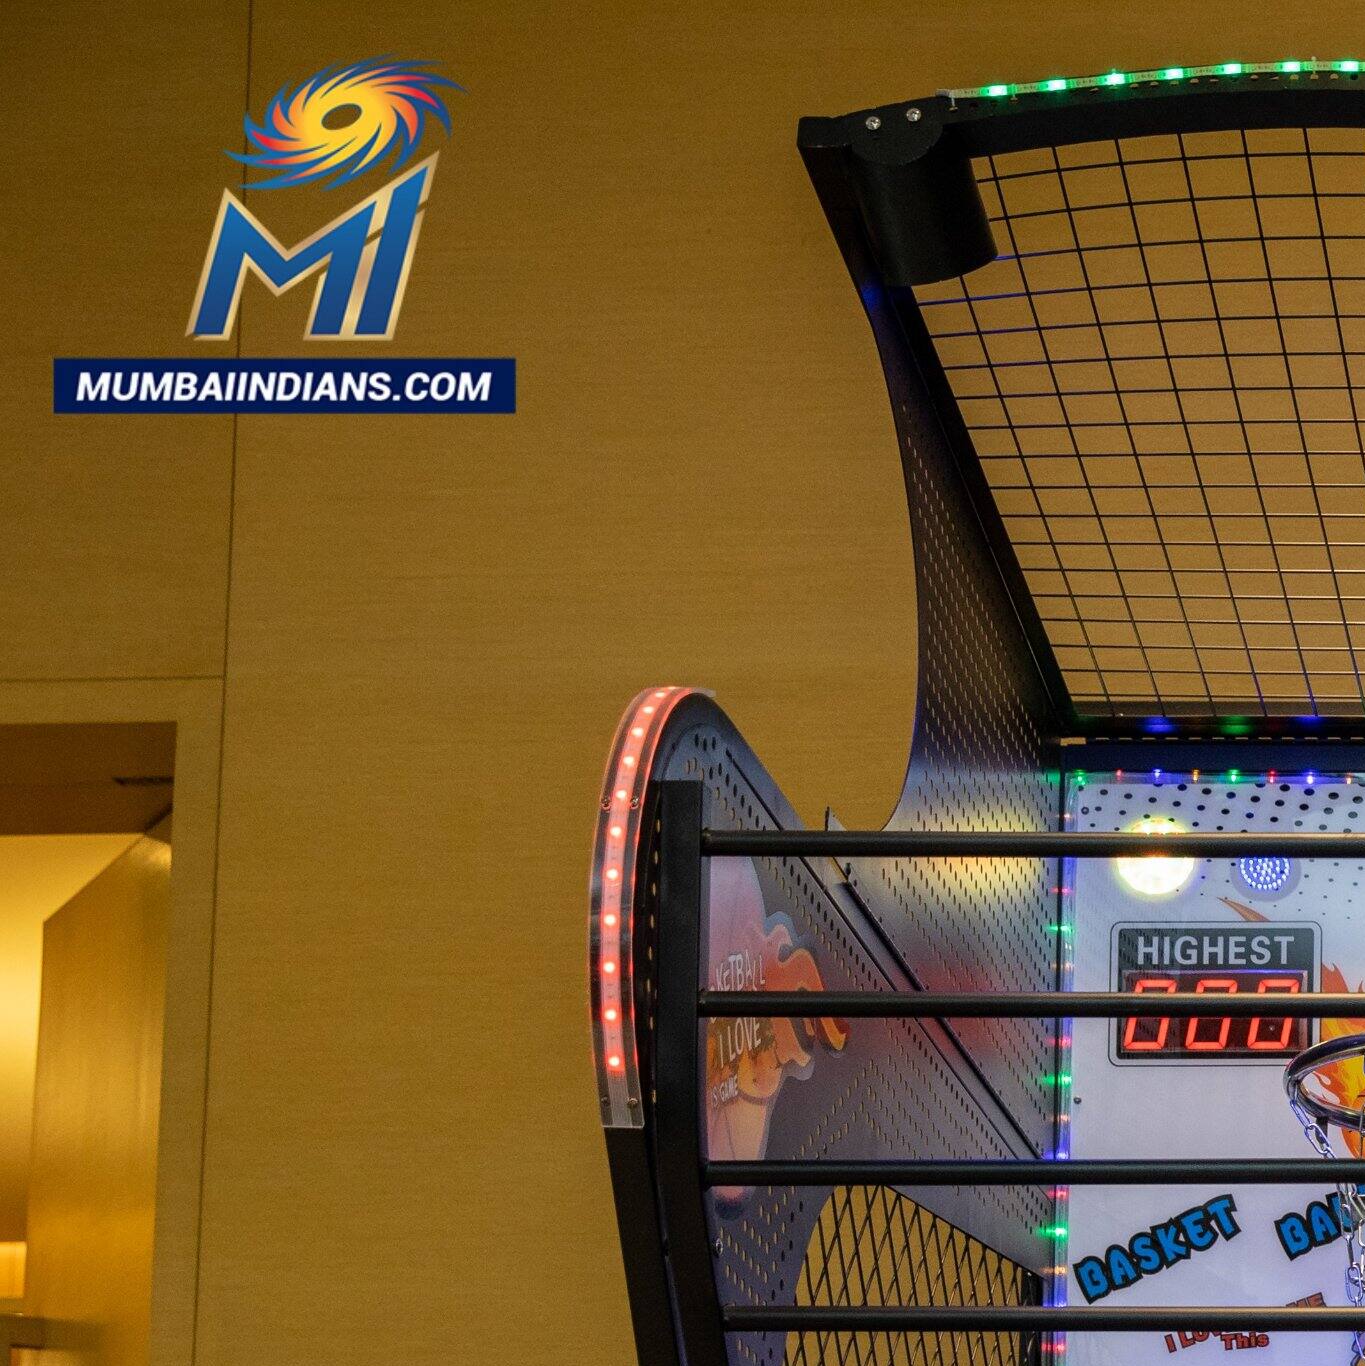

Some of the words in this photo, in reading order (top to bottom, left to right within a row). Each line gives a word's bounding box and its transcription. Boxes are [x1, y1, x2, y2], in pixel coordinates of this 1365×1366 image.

[1136, 935, 1296, 966] HIGHEST
[1073, 1194, 1242, 1305] BASKET
[1220, 1331, 1270, 1351] This
